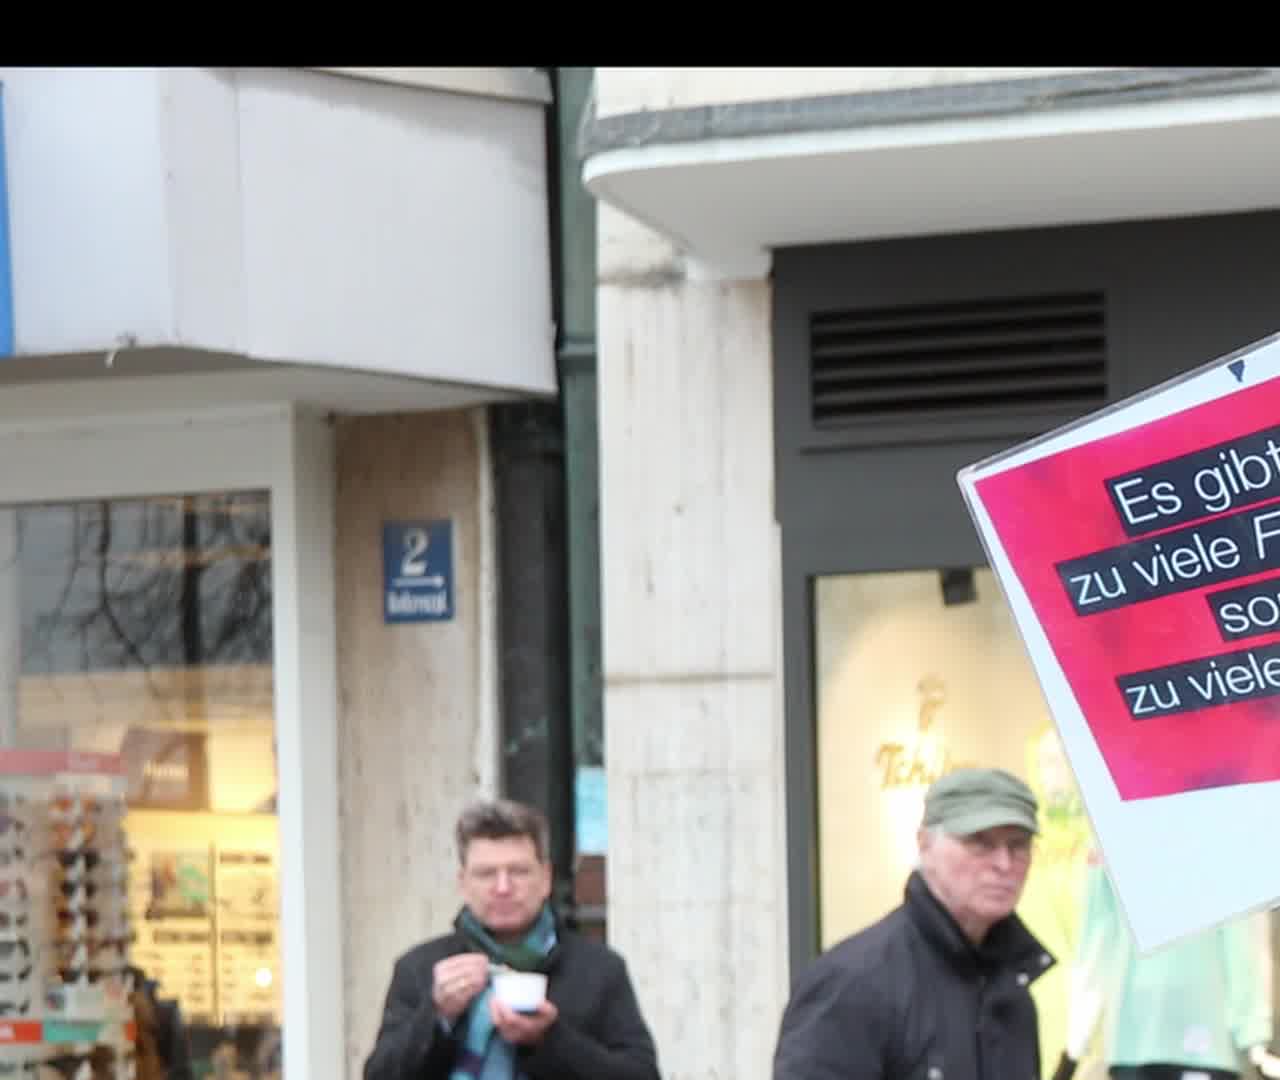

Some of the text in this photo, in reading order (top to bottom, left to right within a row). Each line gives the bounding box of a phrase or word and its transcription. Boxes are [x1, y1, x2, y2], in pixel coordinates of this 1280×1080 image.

[1114, 478, 1181, 524] Es
[402, 529, 429, 576] 2
[1070, 567, 1126, 605] zu
[1135, 534, 1240, 586] viele
[1126, 681, 1180, 714] zu
